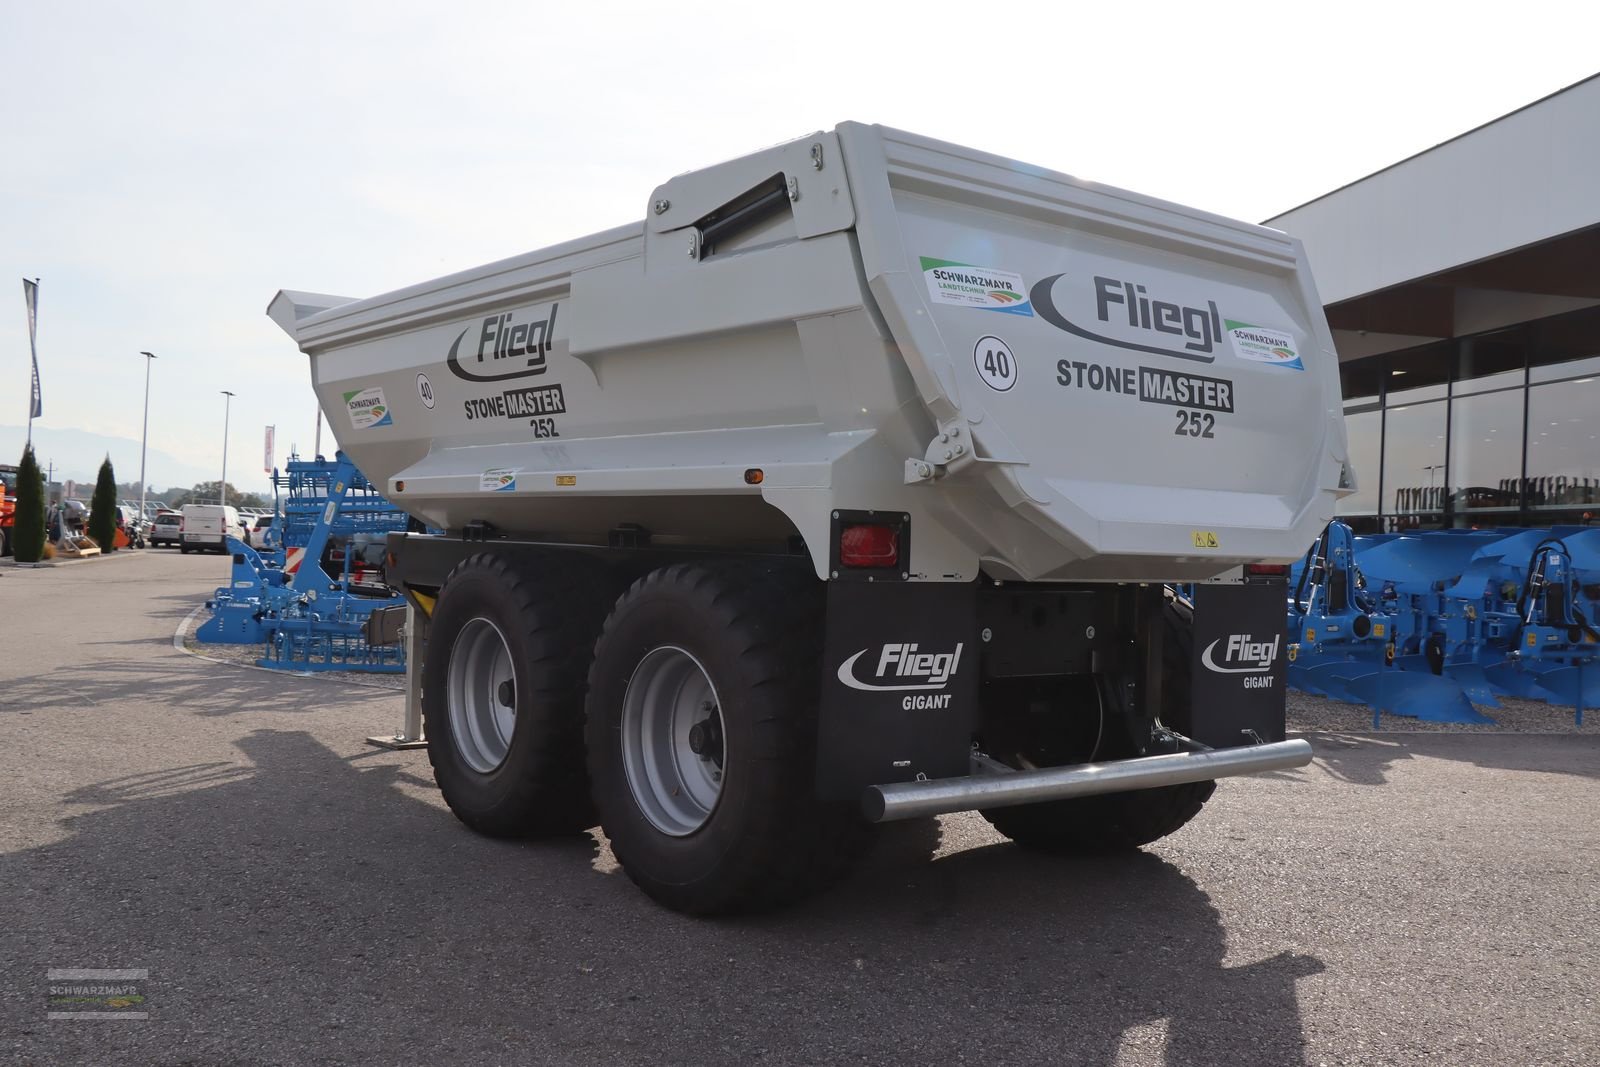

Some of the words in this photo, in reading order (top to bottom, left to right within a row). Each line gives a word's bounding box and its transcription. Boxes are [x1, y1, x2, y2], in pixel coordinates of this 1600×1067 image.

[933, 269, 1013, 291] SCHWARZMAYR
[938, 282, 986, 295] LANDTECHNIK
[1093, 274, 1222, 354] Fliegl
[477, 302, 559, 366] Fliegl
[1234, 329, 1289, 348] SCHWARZMAYR
[983, 349, 1010, 379] 40
[420, 388, 432, 401] 40
[1056, 359, 1137, 396] STONE
[1142, 369, 1232, 410] MASTER
[464, 396, 506, 420] STONE
[506, 388, 564, 417] MASTER
[530, 418, 560, 439] 252
[1174, 410, 1215, 439] 252
[875, 642, 963, 682] Fliegl
[1225, 633, 1279, 666] Fliegl
[1243, 675, 1274, 689] GIGANT
[902, 694, 952, 711] GIGANT
